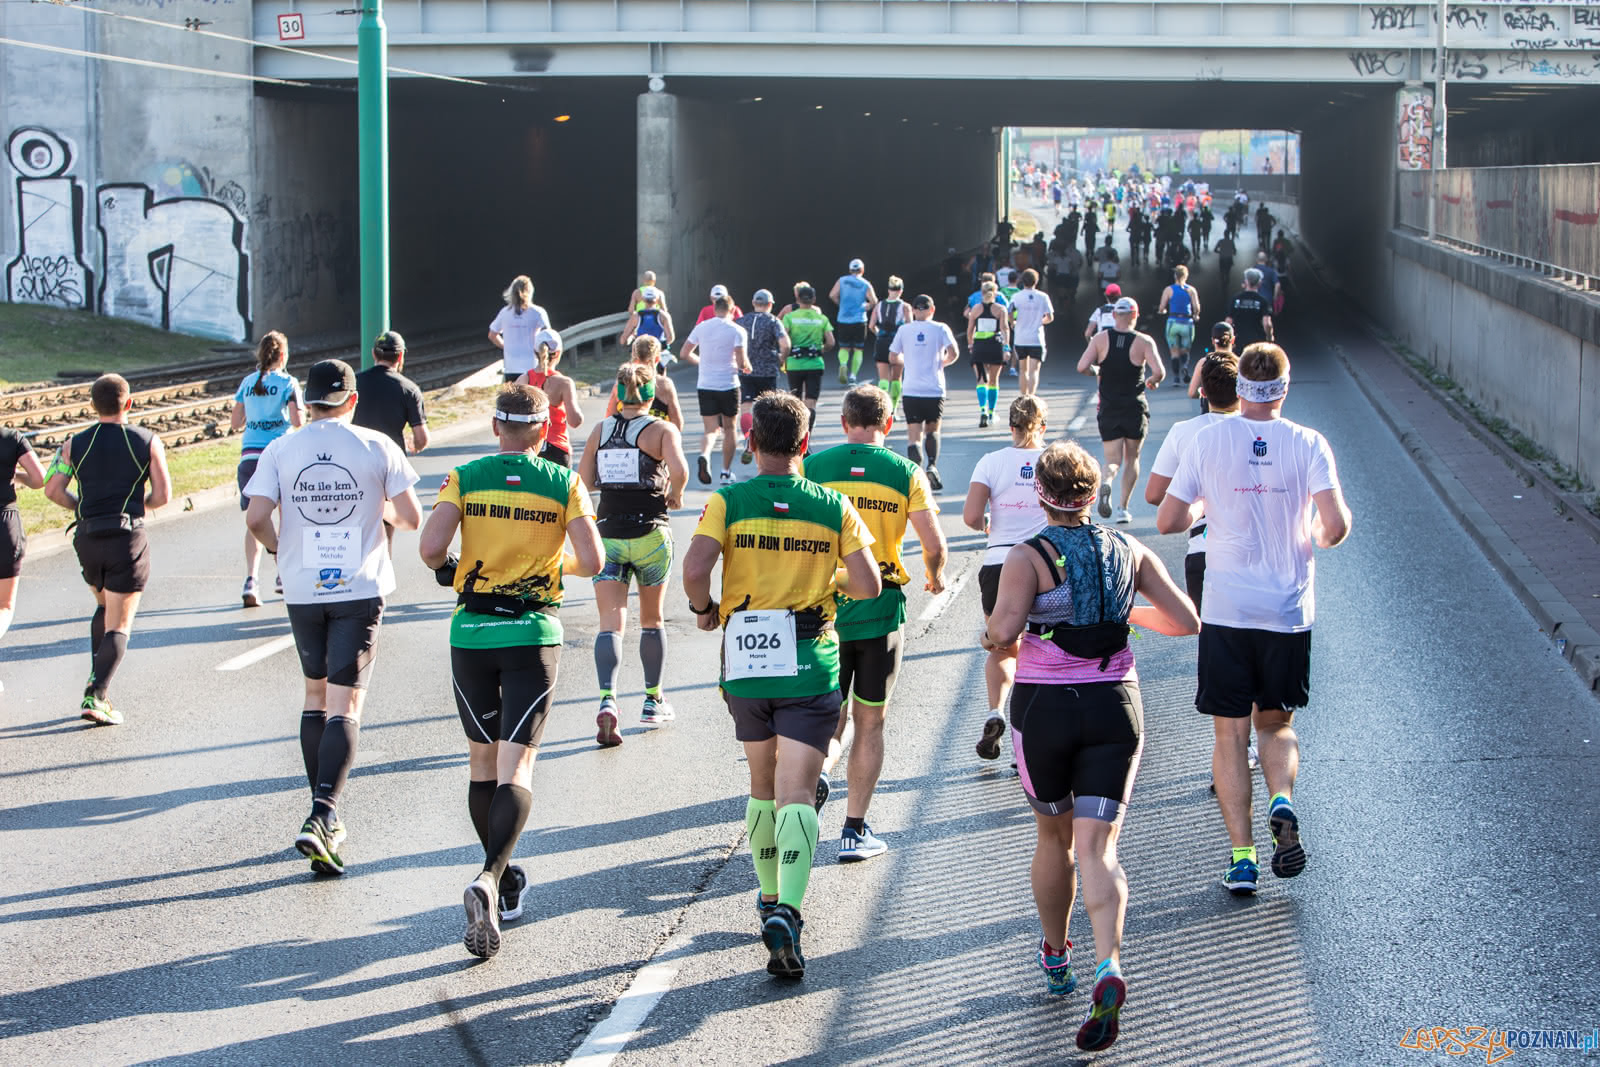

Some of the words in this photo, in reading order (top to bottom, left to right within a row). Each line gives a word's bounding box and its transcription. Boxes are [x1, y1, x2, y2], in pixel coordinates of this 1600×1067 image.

[282, 20, 300, 33] 30
[300, 482, 315, 491] Na
[318, 482, 332, 491] ile
[335, 481, 351, 490] km
[292, 494, 308, 503] ten
[311, 491, 364, 502] maraton?
[857, 496, 899, 513] Oleszyce
[466, 503, 486, 516] RUN
[489, 504, 511, 519] RUN
[514, 507, 558, 524] Oleszyce
[758, 534, 780, 551] RUN
[783, 537, 831, 554] Oleszyce
[736, 633, 782, 651] 1026
